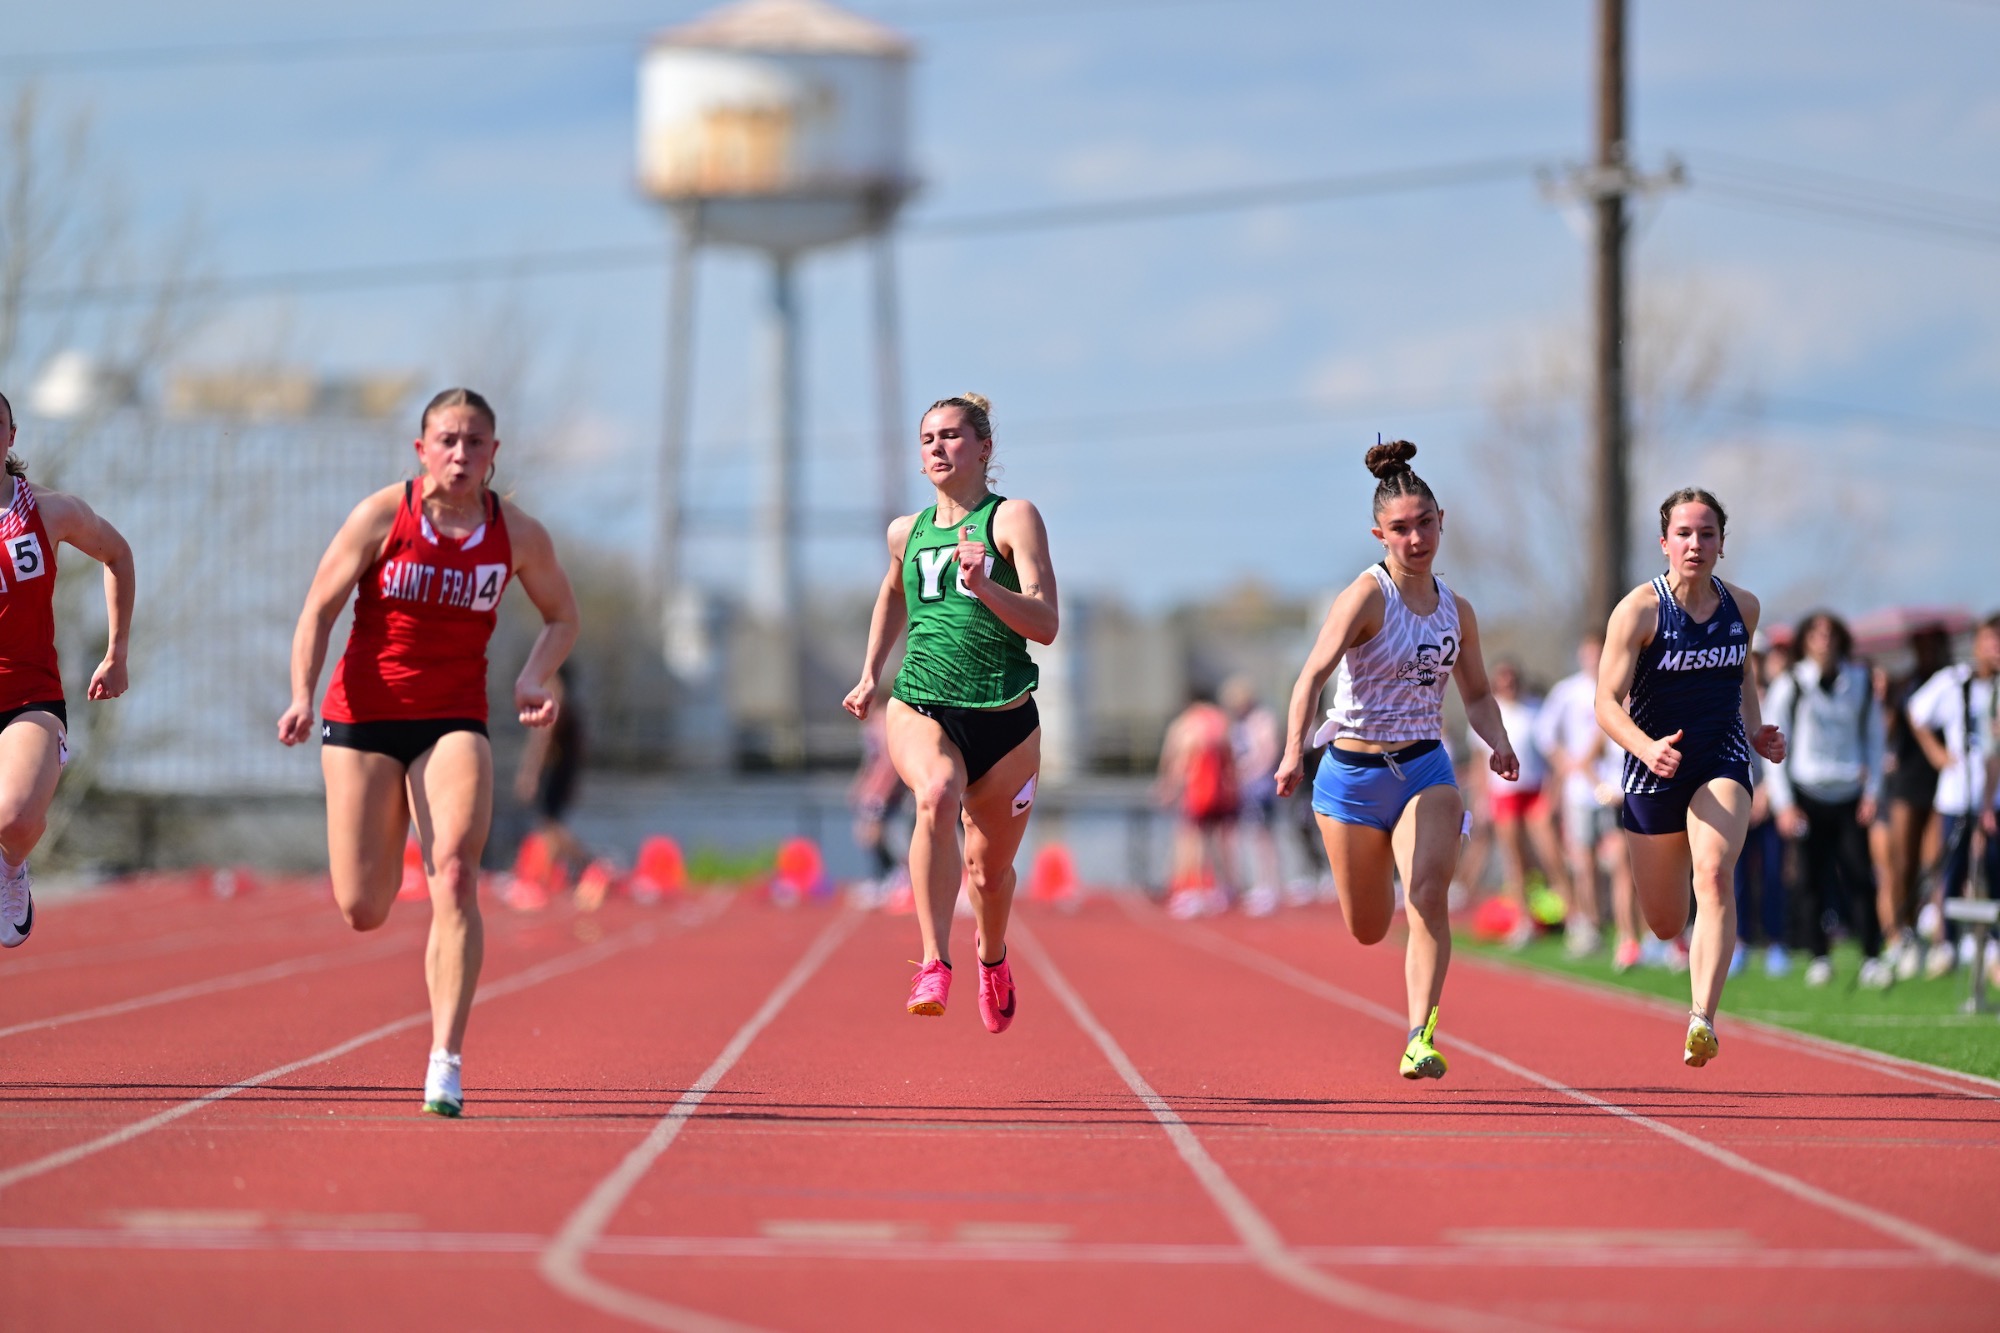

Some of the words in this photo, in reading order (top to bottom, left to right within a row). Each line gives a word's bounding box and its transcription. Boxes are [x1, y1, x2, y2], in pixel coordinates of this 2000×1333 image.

[15, 540, 38, 573] 5
[382, 560, 435, 603] SAINT
[479, 570, 498, 604] 4
[1441, 635, 1456, 666] 2
[1657, 644, 1747, 671] MESSIAH
